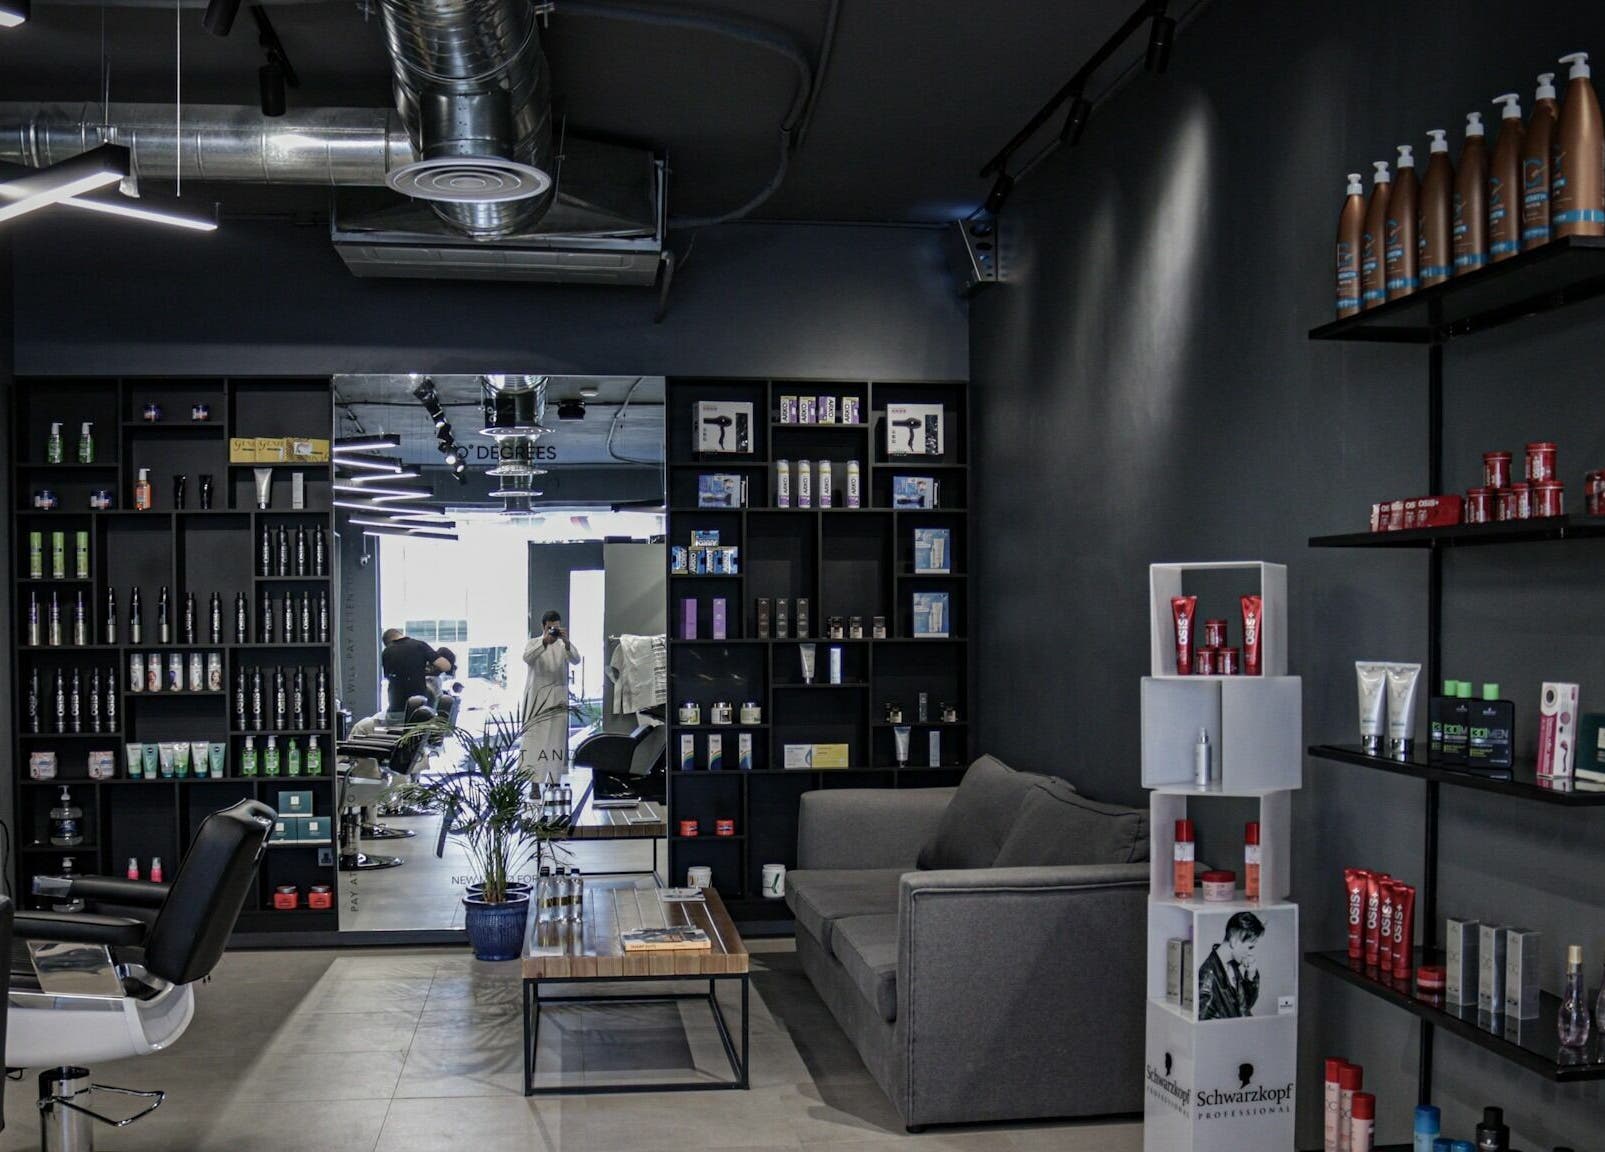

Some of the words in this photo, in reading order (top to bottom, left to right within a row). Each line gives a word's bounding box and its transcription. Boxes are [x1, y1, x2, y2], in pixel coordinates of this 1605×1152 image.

[477, 446, 557, 460] DEGREES
[1146, 1064, 1191, 1106] Schwarzkopf
[1197, 1082, 1294, 1107] Schwarzkopf
[1198, 1105, 1290, 1120] PROFESSIONAL
